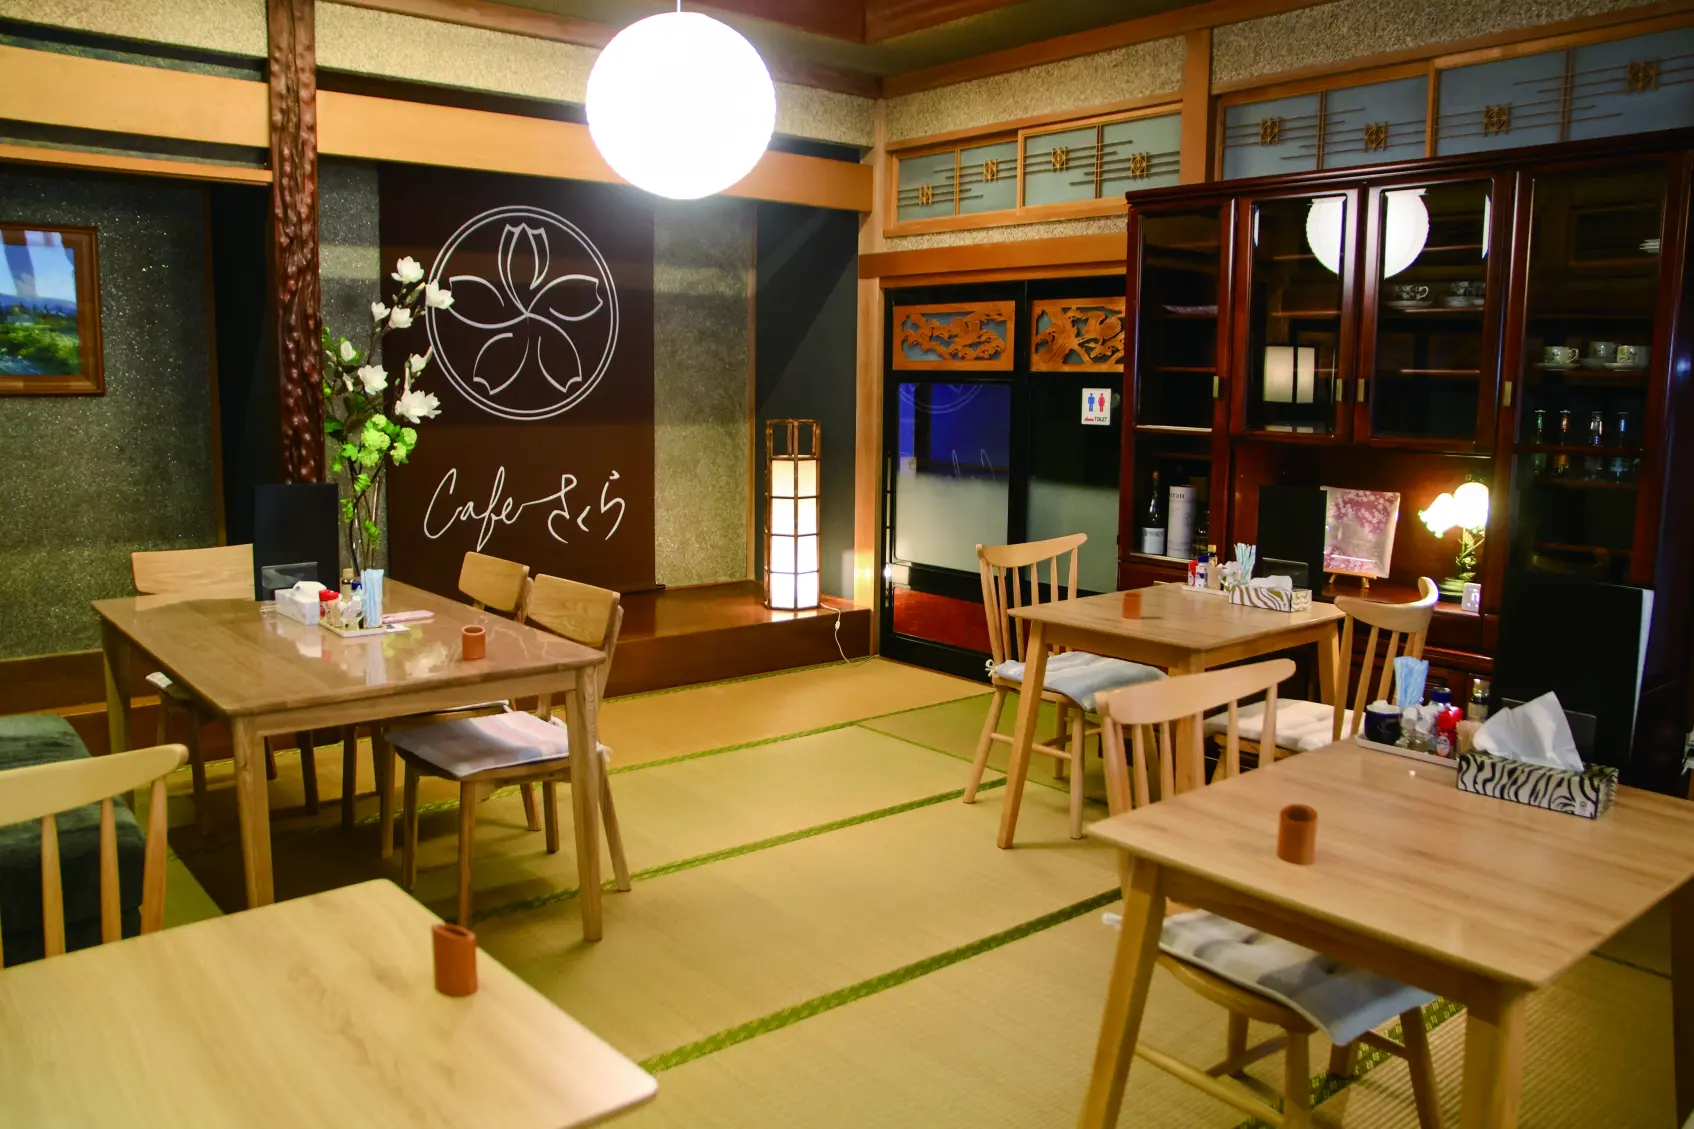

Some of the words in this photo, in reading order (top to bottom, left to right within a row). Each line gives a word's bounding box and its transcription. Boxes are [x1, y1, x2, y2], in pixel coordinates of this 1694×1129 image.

[423, 465, 523, 552] Cafe
[530, 470, 626, 544] さくら
